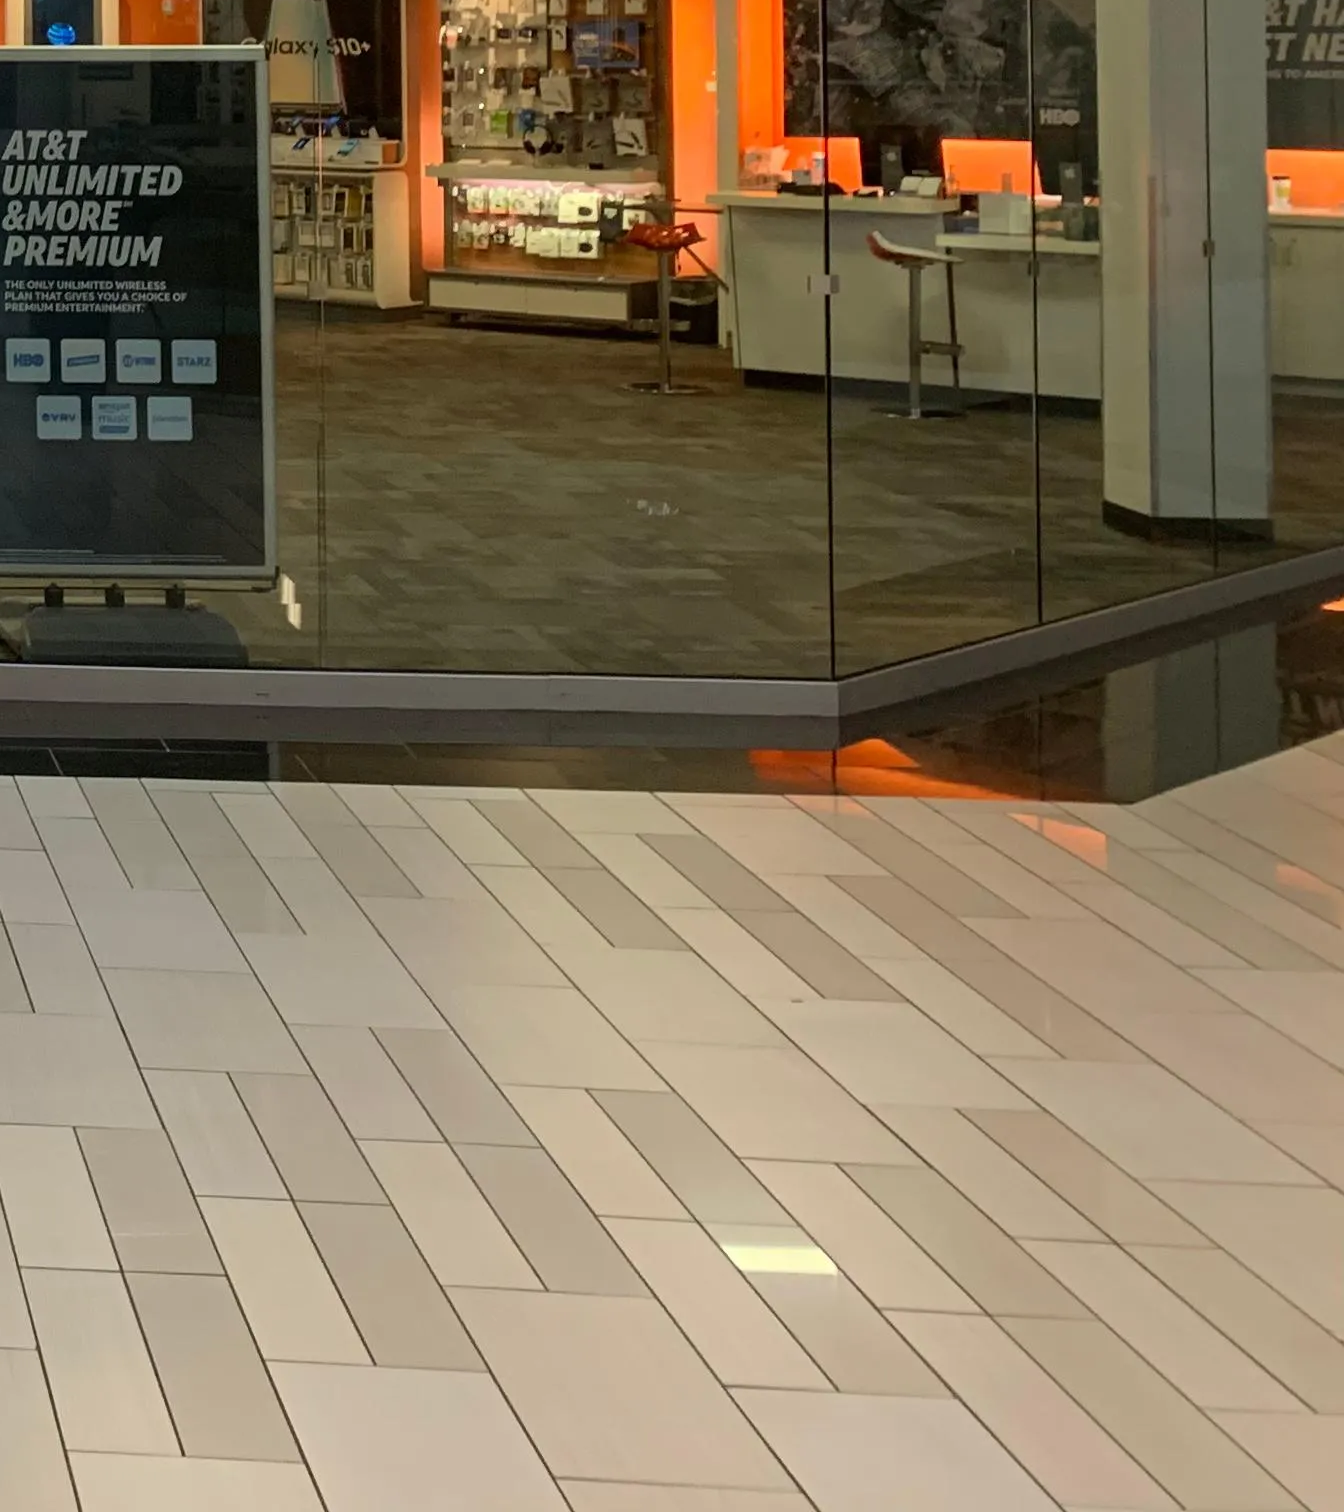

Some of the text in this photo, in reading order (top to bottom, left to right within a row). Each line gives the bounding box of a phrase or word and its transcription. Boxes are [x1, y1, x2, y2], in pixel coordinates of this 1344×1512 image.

[326, 37, 372, 57] S10+
[1039, 108, 1080, 127] HBO
[1, 129, 88, 161] AT&T
[2, 165, 183, 196] UNLIMITED
[3, 235, 163, 267] PREMIUM
[5, 280, 167, 290] THE ONLY UNLIMITED WIRELESS
[5, 291, 187, 302] PLAN THAT GIVES YOU A CHOICE OF
[5, 302, 54, 312] PREMIUM
[13, 353, 44, 368] HBO
[177, 356, 212, 367] STARZ
